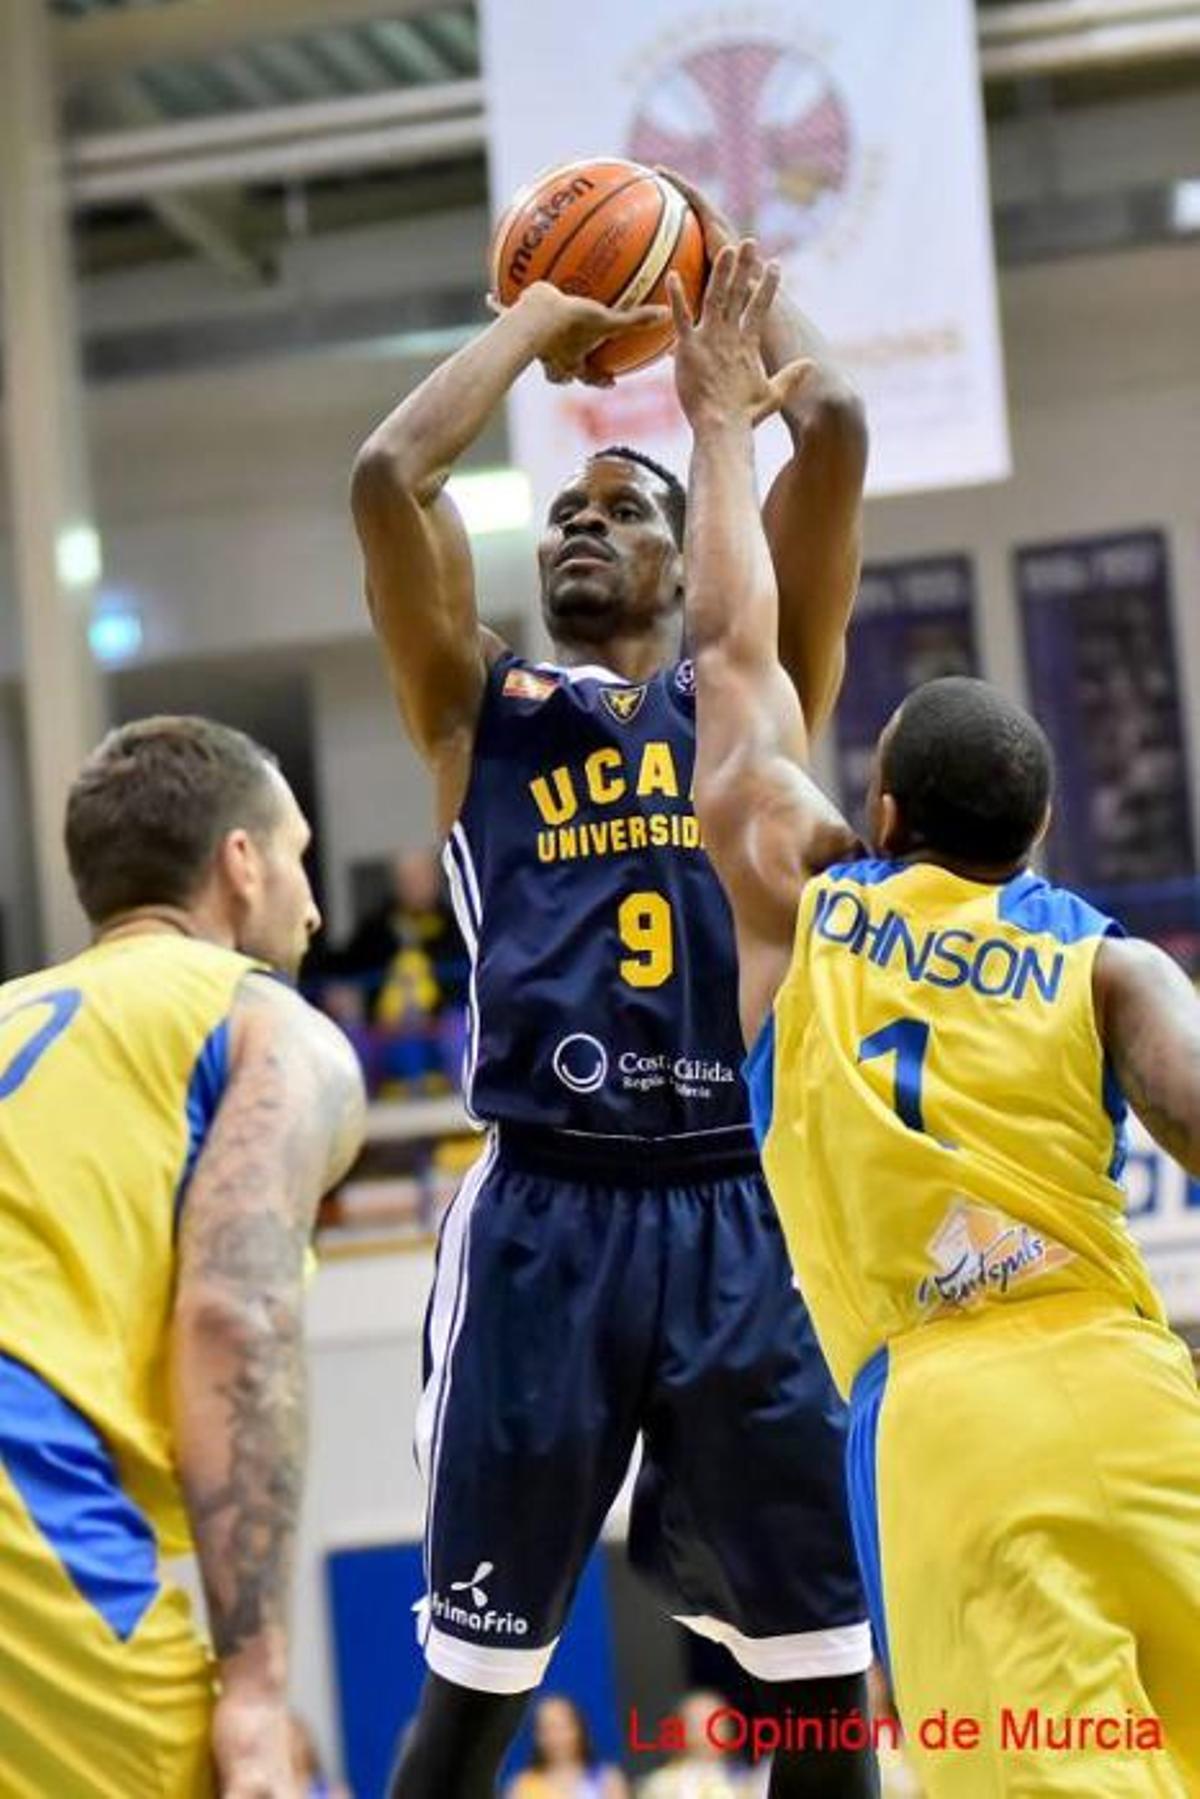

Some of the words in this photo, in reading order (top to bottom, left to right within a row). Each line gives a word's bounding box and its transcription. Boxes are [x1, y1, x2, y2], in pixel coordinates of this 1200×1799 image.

[508, 177, 595, 287] molten
[529, 741, 695, 826] UCA
[536, 814, 705, 864] UNIVERSID
[617, 890, 675, 989] 9
[618, 1052, 671, 1075] Cost
[857, 1017, 933, 1134] 1
